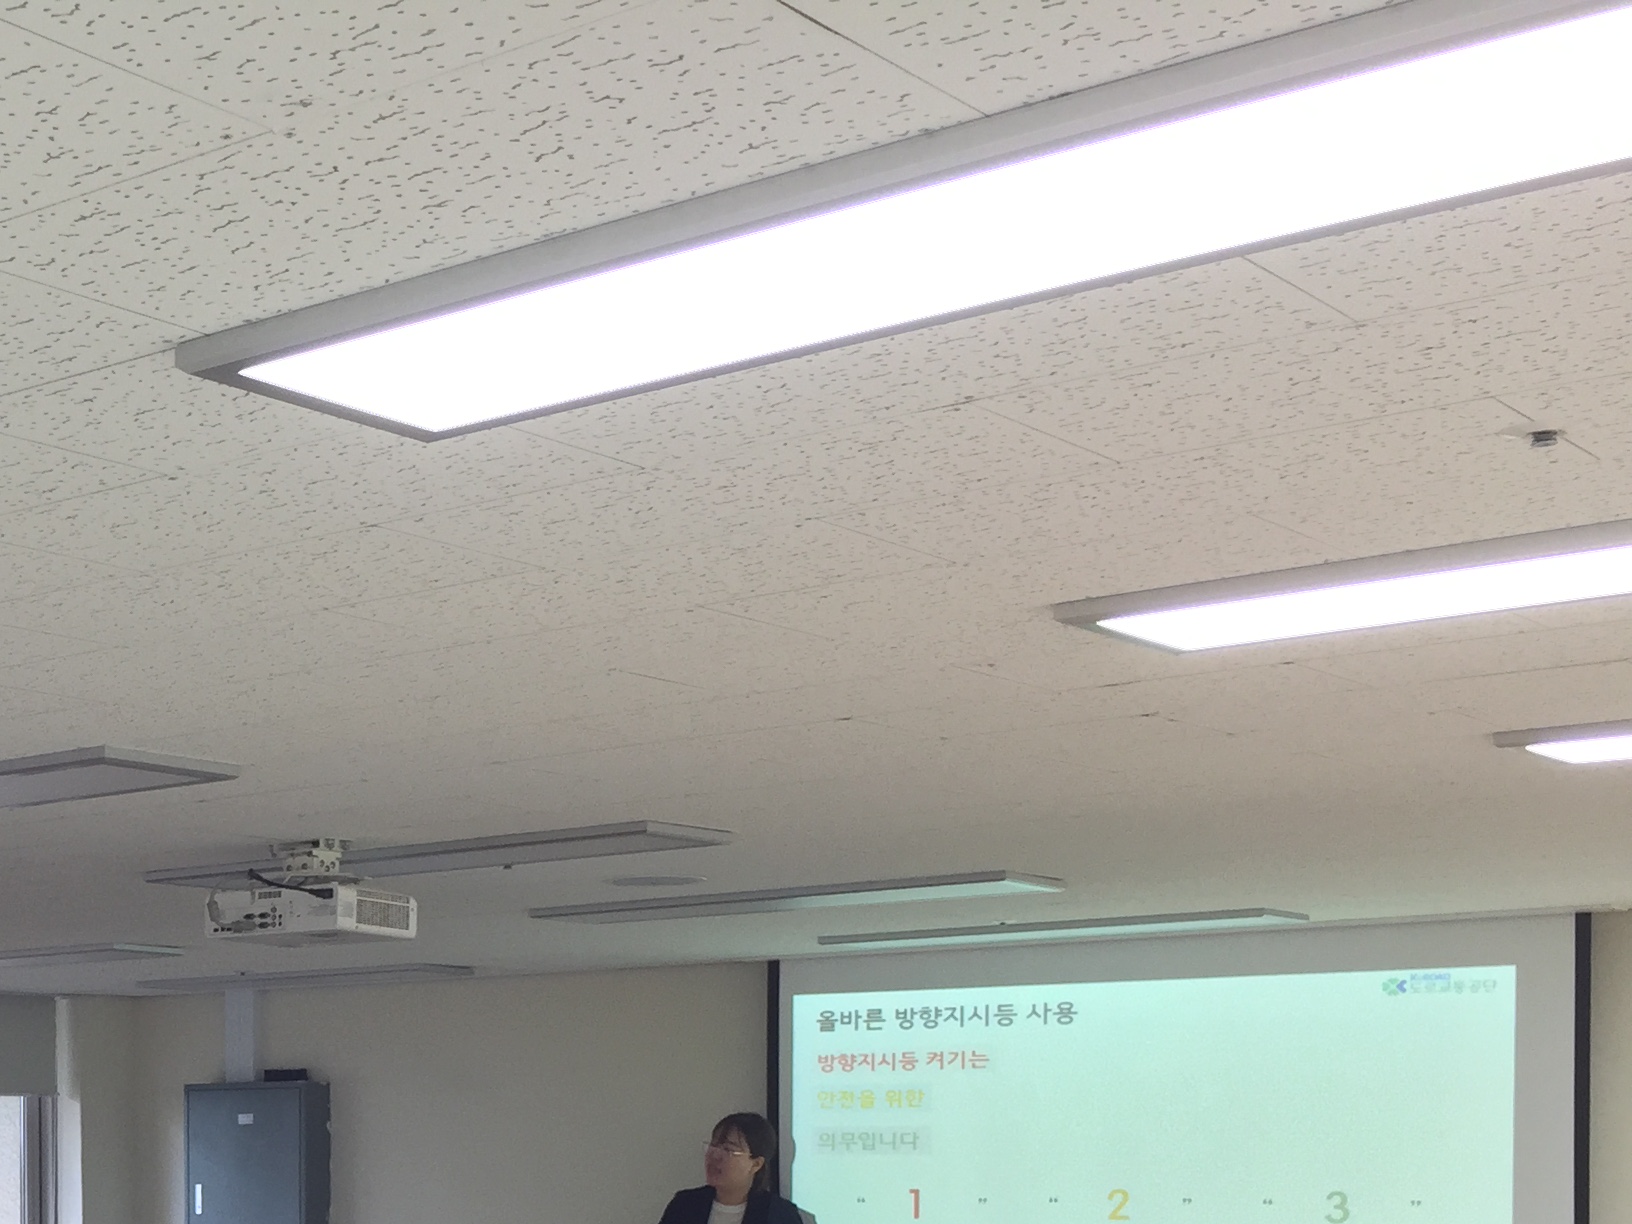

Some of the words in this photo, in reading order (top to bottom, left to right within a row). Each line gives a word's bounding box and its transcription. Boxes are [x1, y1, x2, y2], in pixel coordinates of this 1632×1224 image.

[817, 1009, 886, 1032] 올바른
[895, 1003, 1018, 1030] 방향지시등
[1026, 1002, 1078, 1025] 사용
[818, 1052, 918, 1073] 방향지시등
[926, 1050, 990, 1070] 켜기는
[817, 1090, 876, 1109] 안전을
[885, 1089, 925, 1108] 위한
[818, 1131, 919, 1151] 의무입니다
[909, 1188, 920, 1219] 1
[1107, 1188, 1130, 1221] 2
[1325, 1191, 1350, 1224] 3
